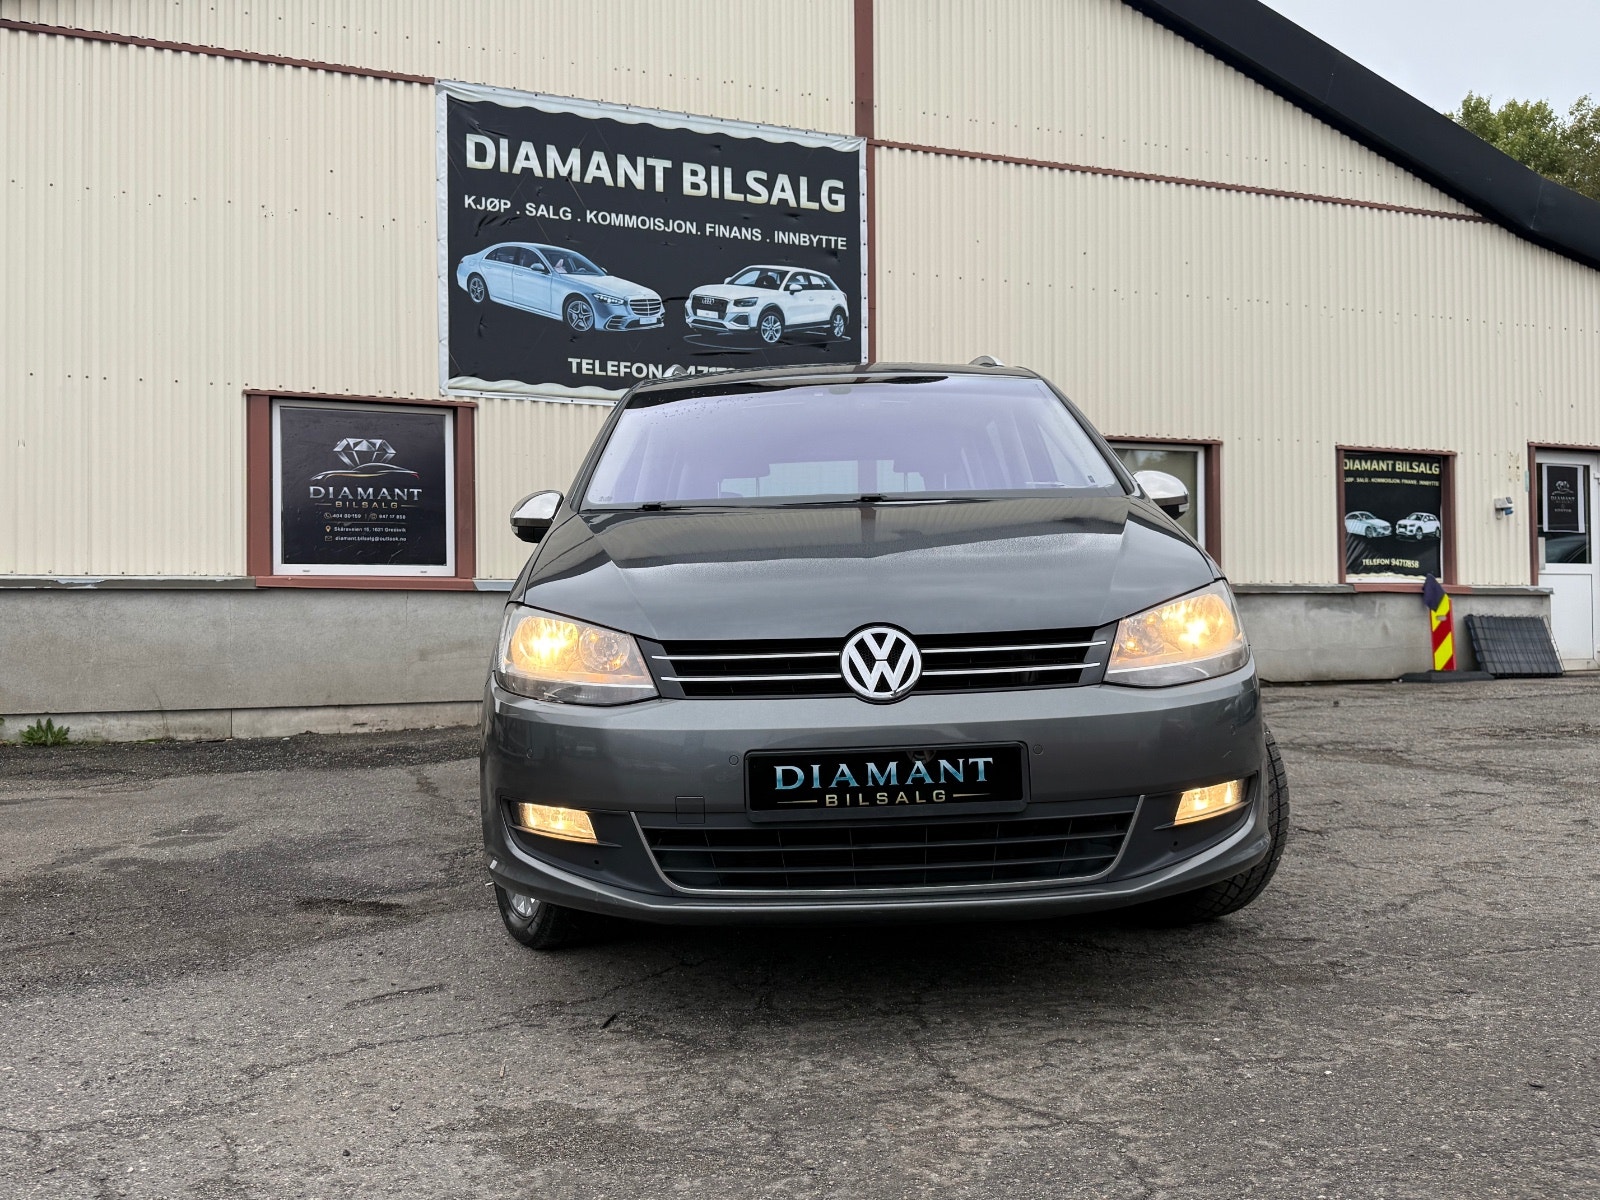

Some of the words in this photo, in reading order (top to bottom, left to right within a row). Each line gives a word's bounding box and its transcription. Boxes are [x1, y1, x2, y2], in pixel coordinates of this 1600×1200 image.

[466, 133, 672, 193] DIAMANT
[682, 161, 846, 213] BILSALG
[464, 194, 511, 213] KJØP
[525, 202, 572, 221] SALG
[705, 223, 762, 242] FINANS
[774, 230, 847, 250] INNBYTTE
[567, 357, 663, 379] TELEFON
[1395, 460, 1440, 475] BILSALG
[309, 486, 422, 501] DIAMANT
[335, 501, 398, 509] BILSALG
[1362, 558, 1390, 566] TELEFON
[845, 629, 917, 696] VW
[773, 757, 994, 791] DIAMANT
[825, 789, 947, 807] BILSALG
